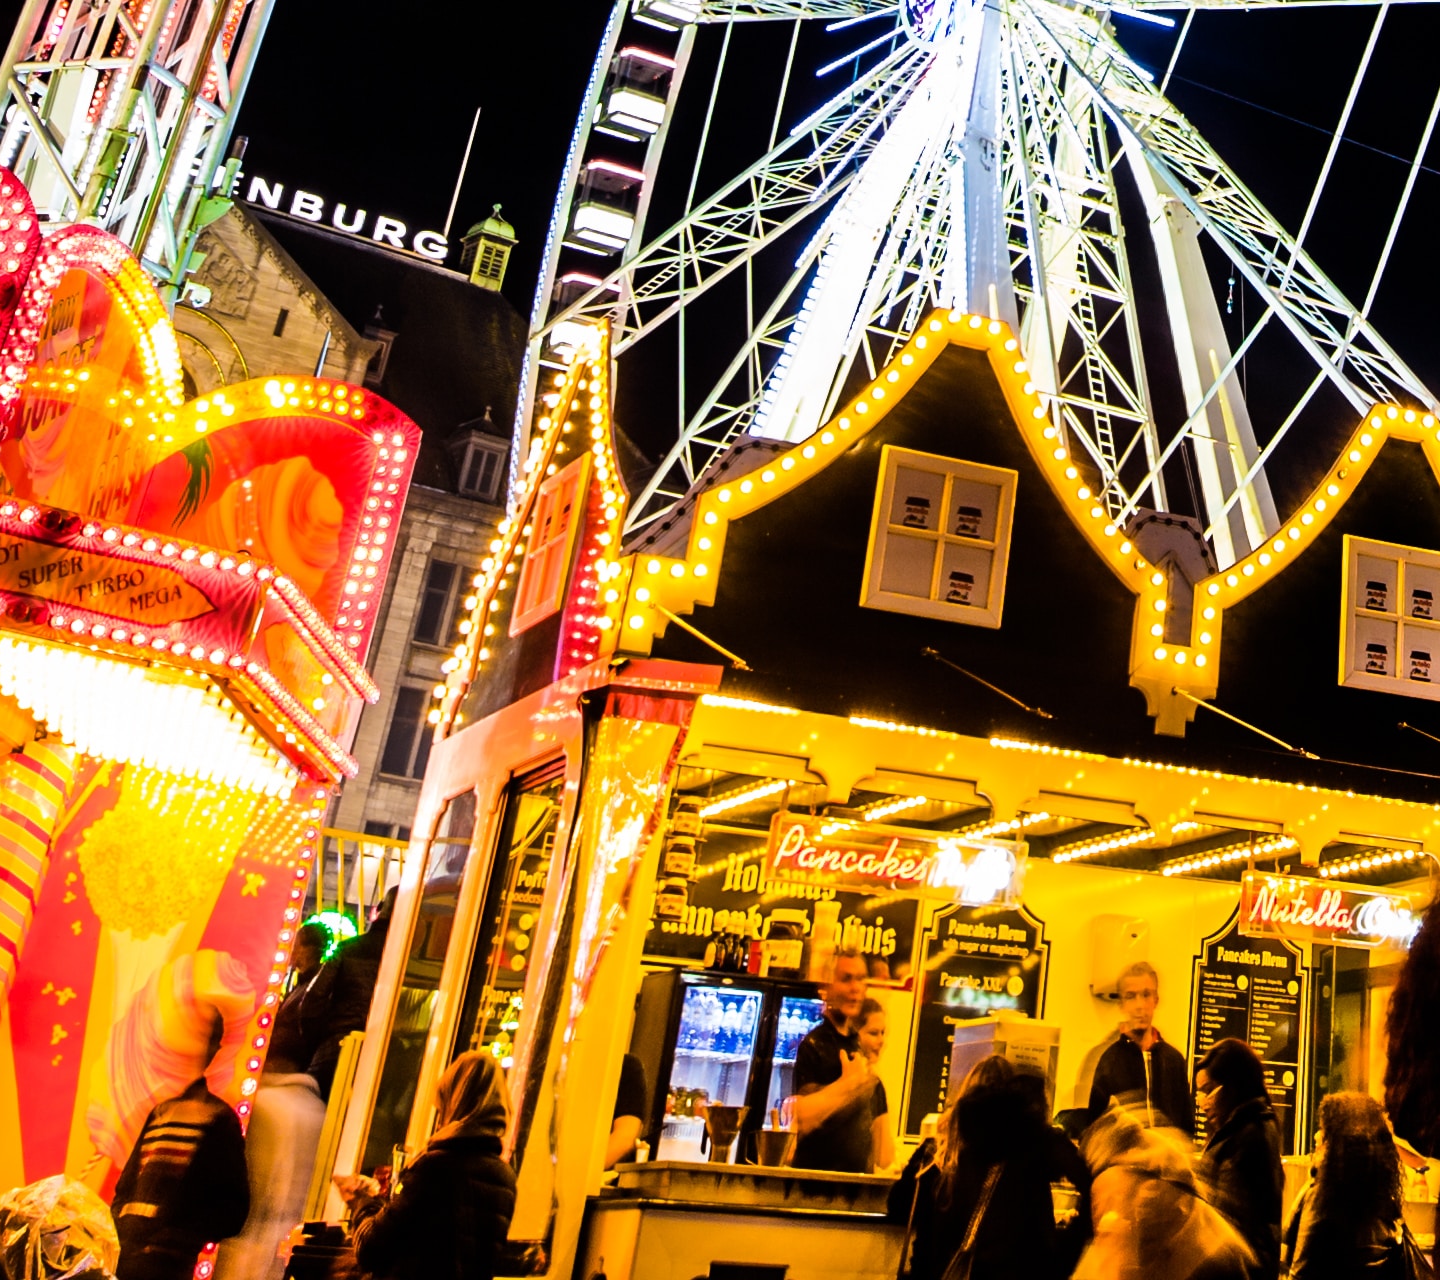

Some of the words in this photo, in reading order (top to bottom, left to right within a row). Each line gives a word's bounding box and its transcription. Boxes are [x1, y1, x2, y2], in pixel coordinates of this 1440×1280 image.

[17, 557, 84, 589] SUPER
[74, 569, 144, 602] TURBO
[129, 586, 183, 614] MEGA
[773, 824, 928, 881] Pancakes
[1248, 885, 1353, 929] Nutella
[948, 918, 997, 939] Pancakes
[997, 923, 1027, 942] Menu
[980, 943, 990, 953] or
[1217, 946, 1261, 966] Pancakes
[1261, 951, 1288, 968] Menu
[940, 972, 981, 990] Pancake
[981, 975, 1002, 992] XXL
